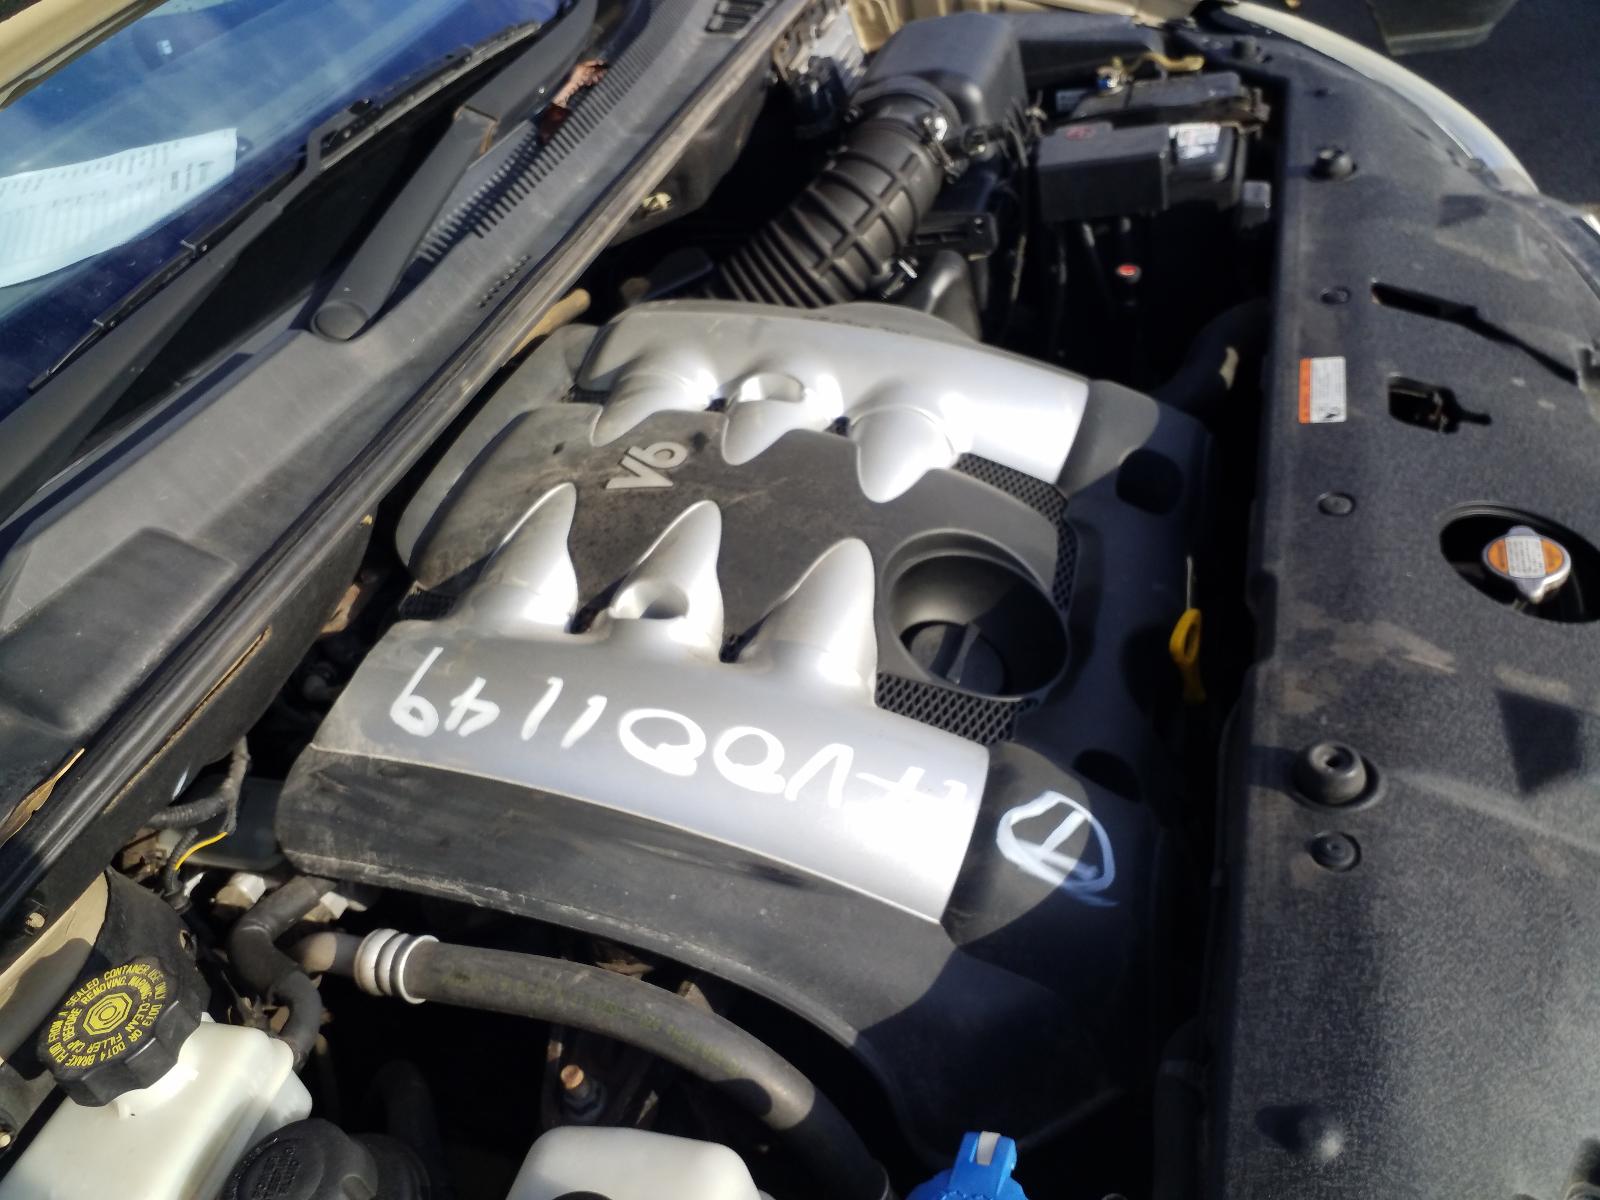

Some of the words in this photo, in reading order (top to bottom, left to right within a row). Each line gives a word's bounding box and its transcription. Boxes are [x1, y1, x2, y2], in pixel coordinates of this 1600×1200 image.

[606, 442, 689, 489] V6
[66, 978, 99, 1006] SEALED
[63, 1008, 82, 1042] BEFORE
[125, 1003, 150, 1032] CLEAN
[48, 1020, 64, 1043] FROM
[128, 1029, 143, 1042] OR
[49, 1042, 69, 1063] FLUID
[67, 1040, 85, 1053] CAP
[87, 1033, 122, 1054] FILLER
[65, 1054, 96, 1066] BRAKE
